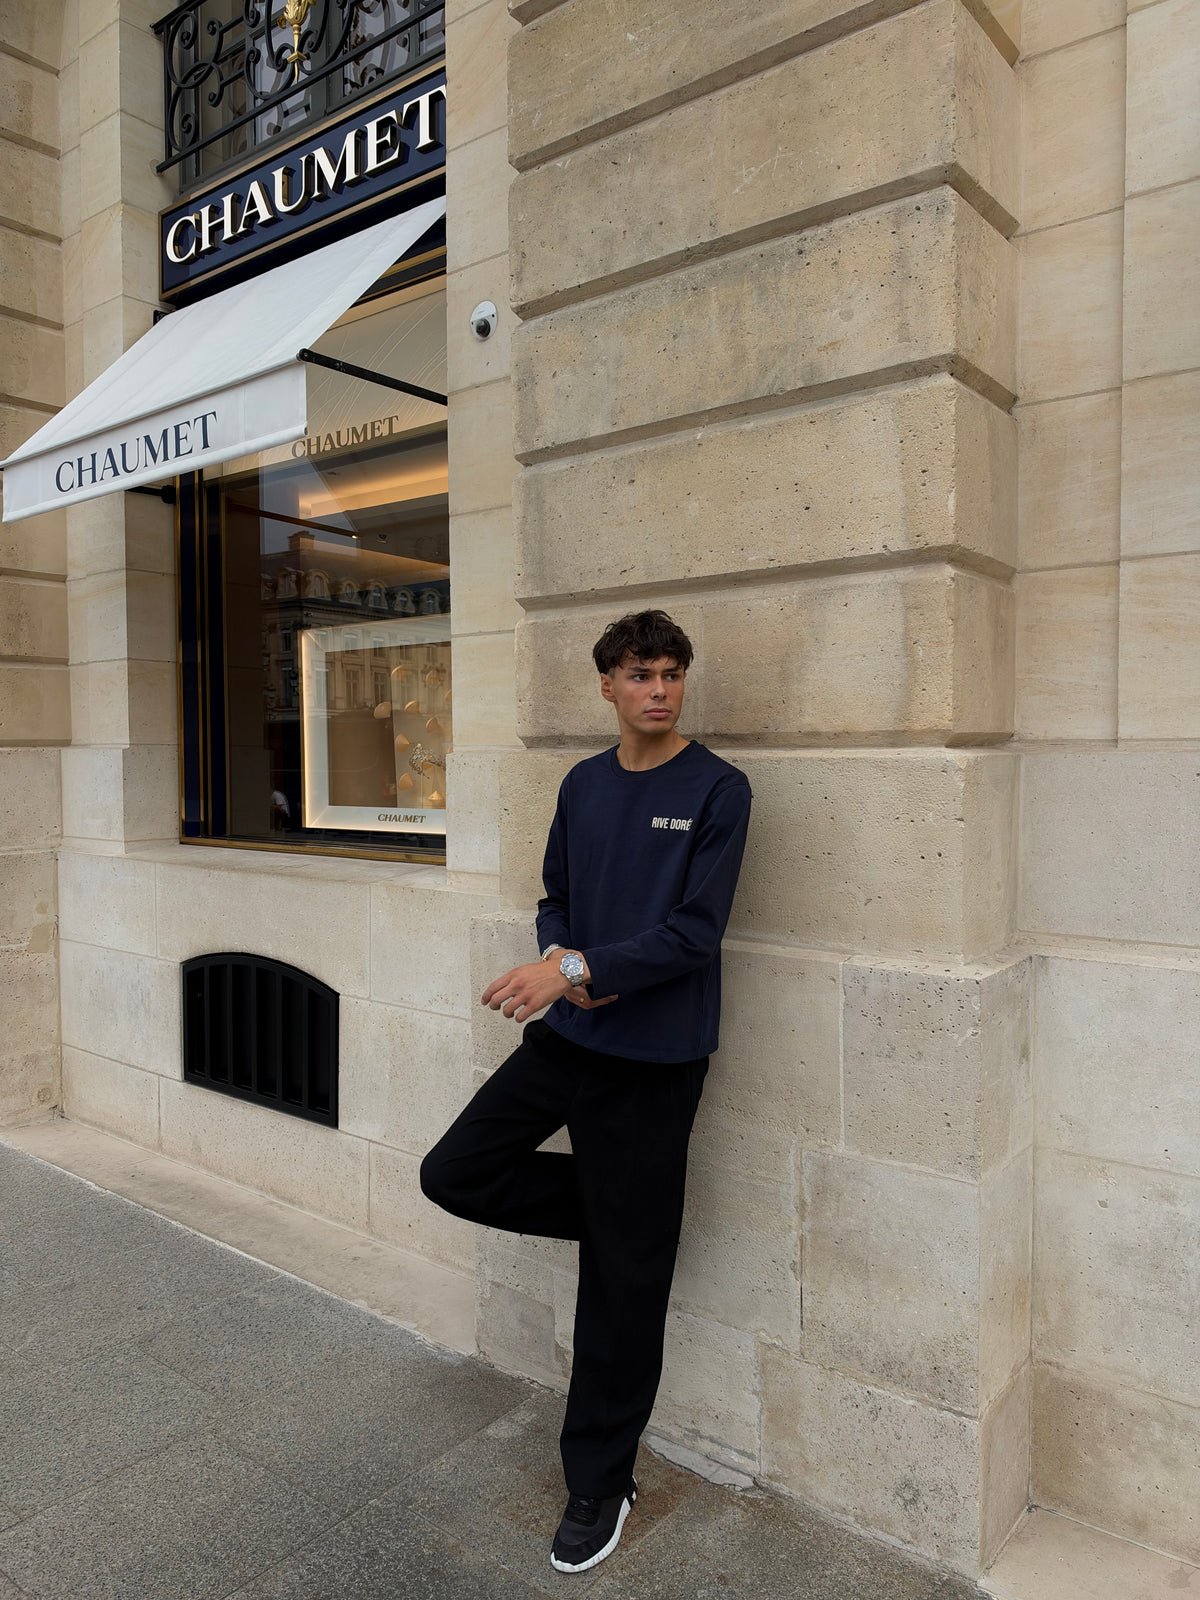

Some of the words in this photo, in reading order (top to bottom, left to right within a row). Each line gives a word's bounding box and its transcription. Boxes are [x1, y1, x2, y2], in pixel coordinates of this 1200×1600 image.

[166, 84, 446, 263] CHAUMET
[55, 411, 217, 493] CHAUMET
[291, 415, 399, 459] CHAUMET
[378, 814, 425, 823] CHAUMET
[652, 817, 669, 829] RIVE
[670, 818, 693, 831] DORÉ
